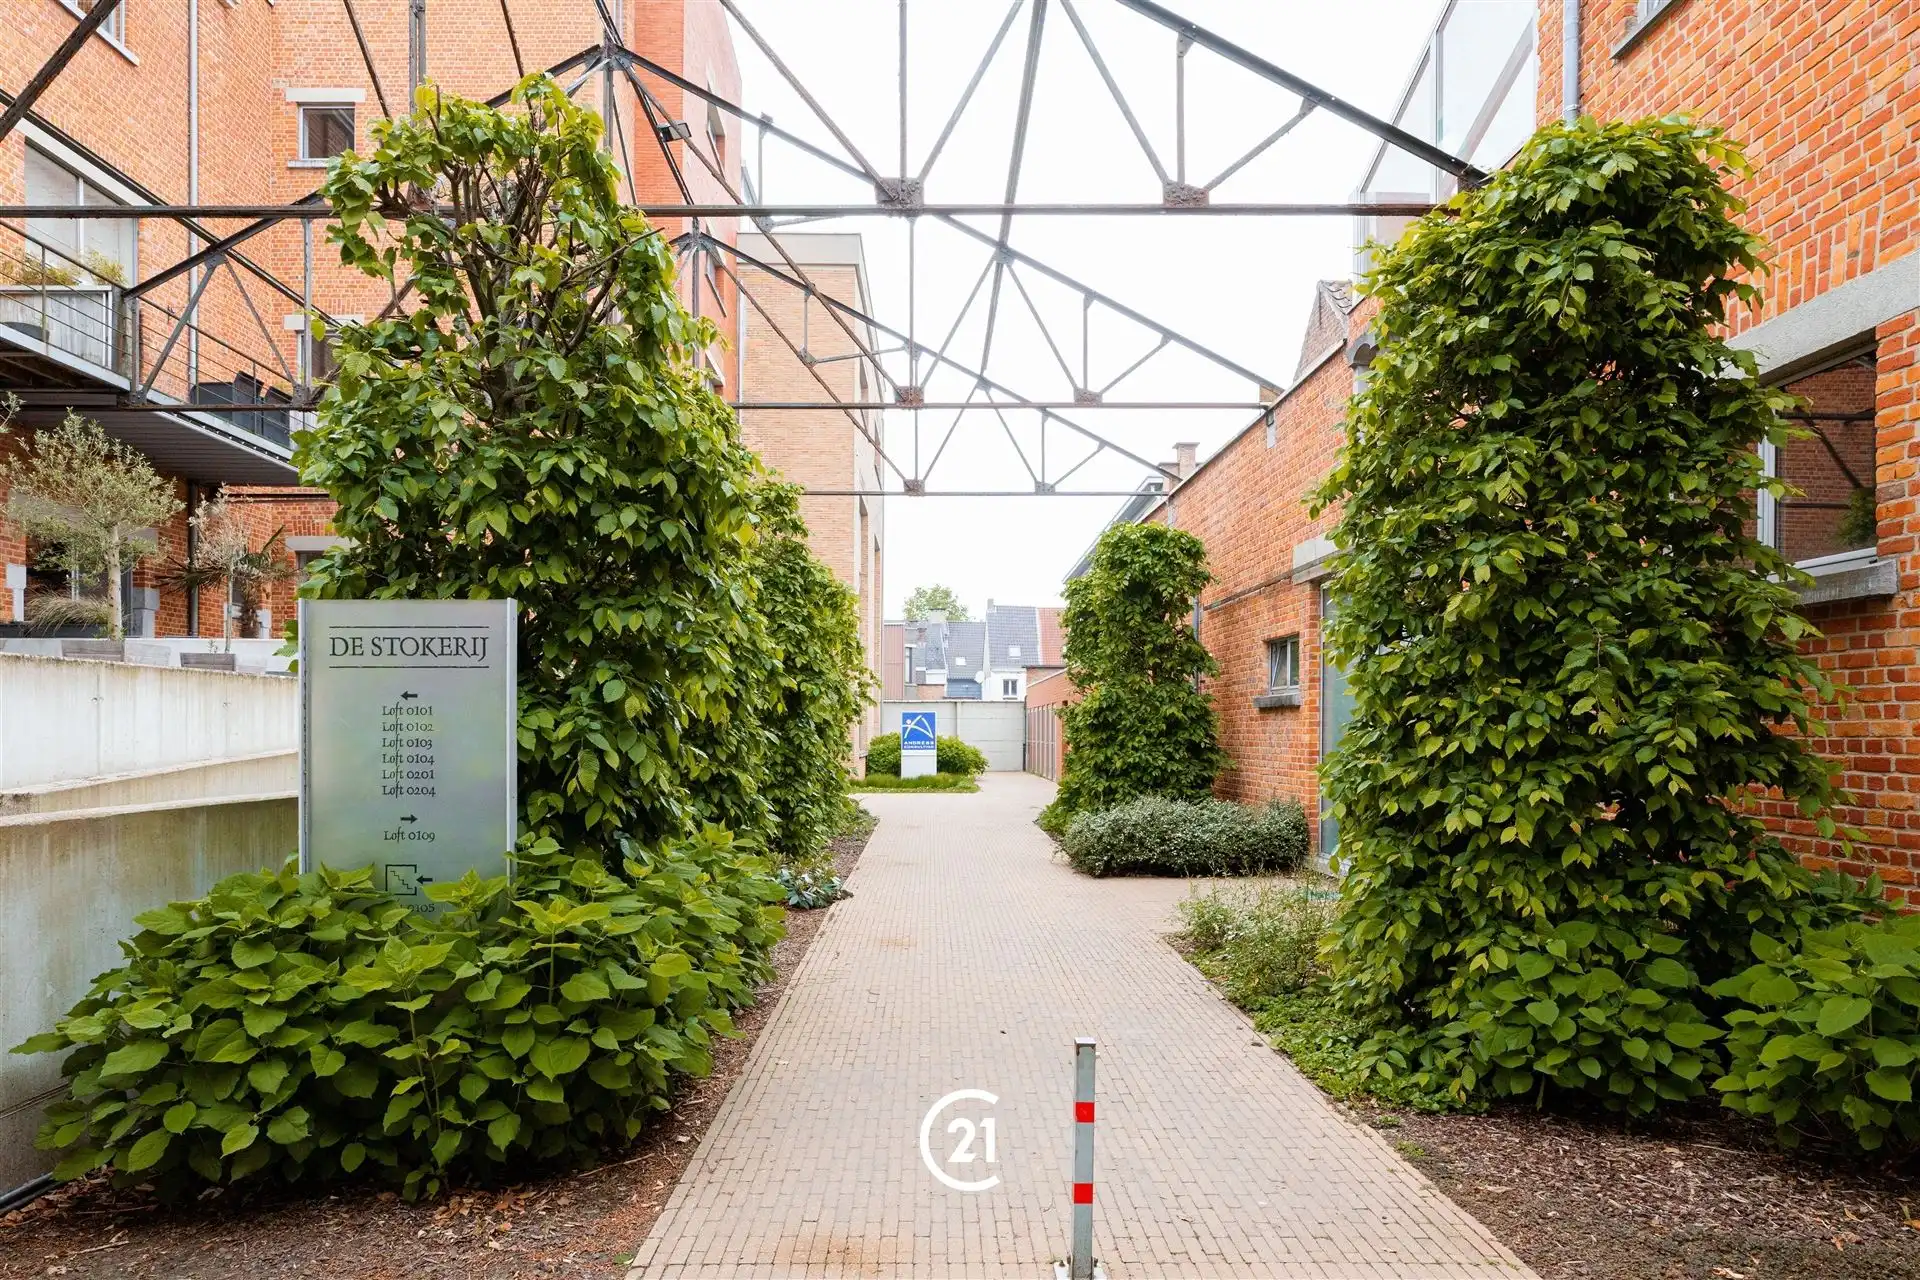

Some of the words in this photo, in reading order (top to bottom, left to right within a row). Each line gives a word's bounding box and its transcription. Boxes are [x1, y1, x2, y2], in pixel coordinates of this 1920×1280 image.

[329, 636, 364, 657] DE
[371, 636, 489, 662] STOKERIJ
[382, 701, 404, 719] Loft
[406, 705, 434, 716] 0101
[382, 718, 404, 735] Loft
[406, 722, 435, 732] 0102
[382, 734, 404, 751] Loft
[406, 737, 433, 750] 0103
[382, 750, 404, 767] Loft
[406, 753, 435, 765] 0104
[382, 765, 404, 782] Loft
[406, 769, 435, 780] 0201
[382, 781, 404, 799] Loft
[406, 786, 436, 798] 0204
[383, 826, 406, 844] Loft
[408, 831, 436, 843] 0109
